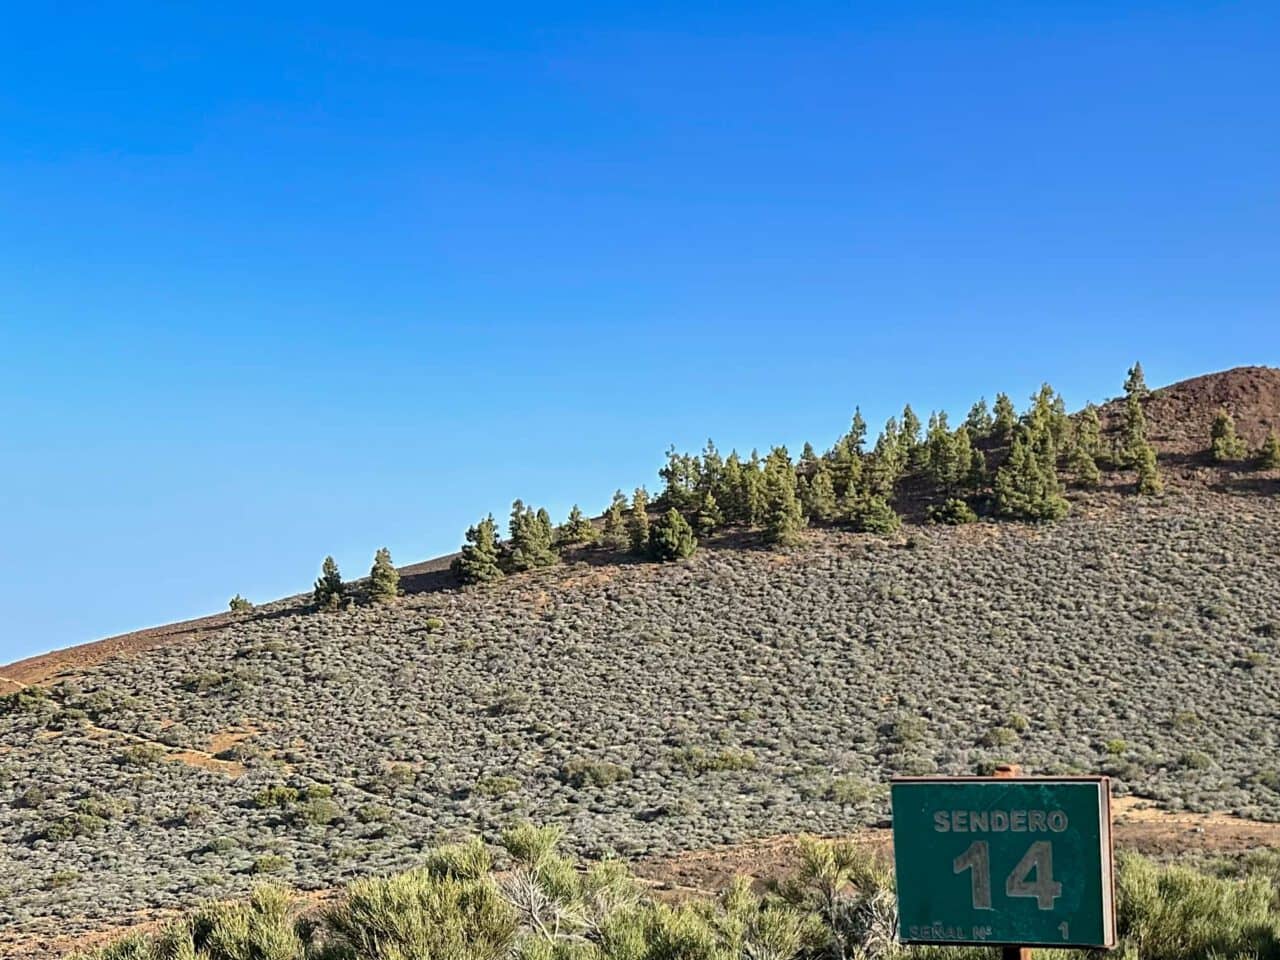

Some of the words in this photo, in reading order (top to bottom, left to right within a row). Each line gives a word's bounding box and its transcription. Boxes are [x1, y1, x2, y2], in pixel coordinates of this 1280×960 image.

[934, 810, 1068, 832] SENDERO
[953, 840, 1062, 910] 14
[909, 921, 965, 939] SEÑAL
[1057, 921, 1069, 940] 1
